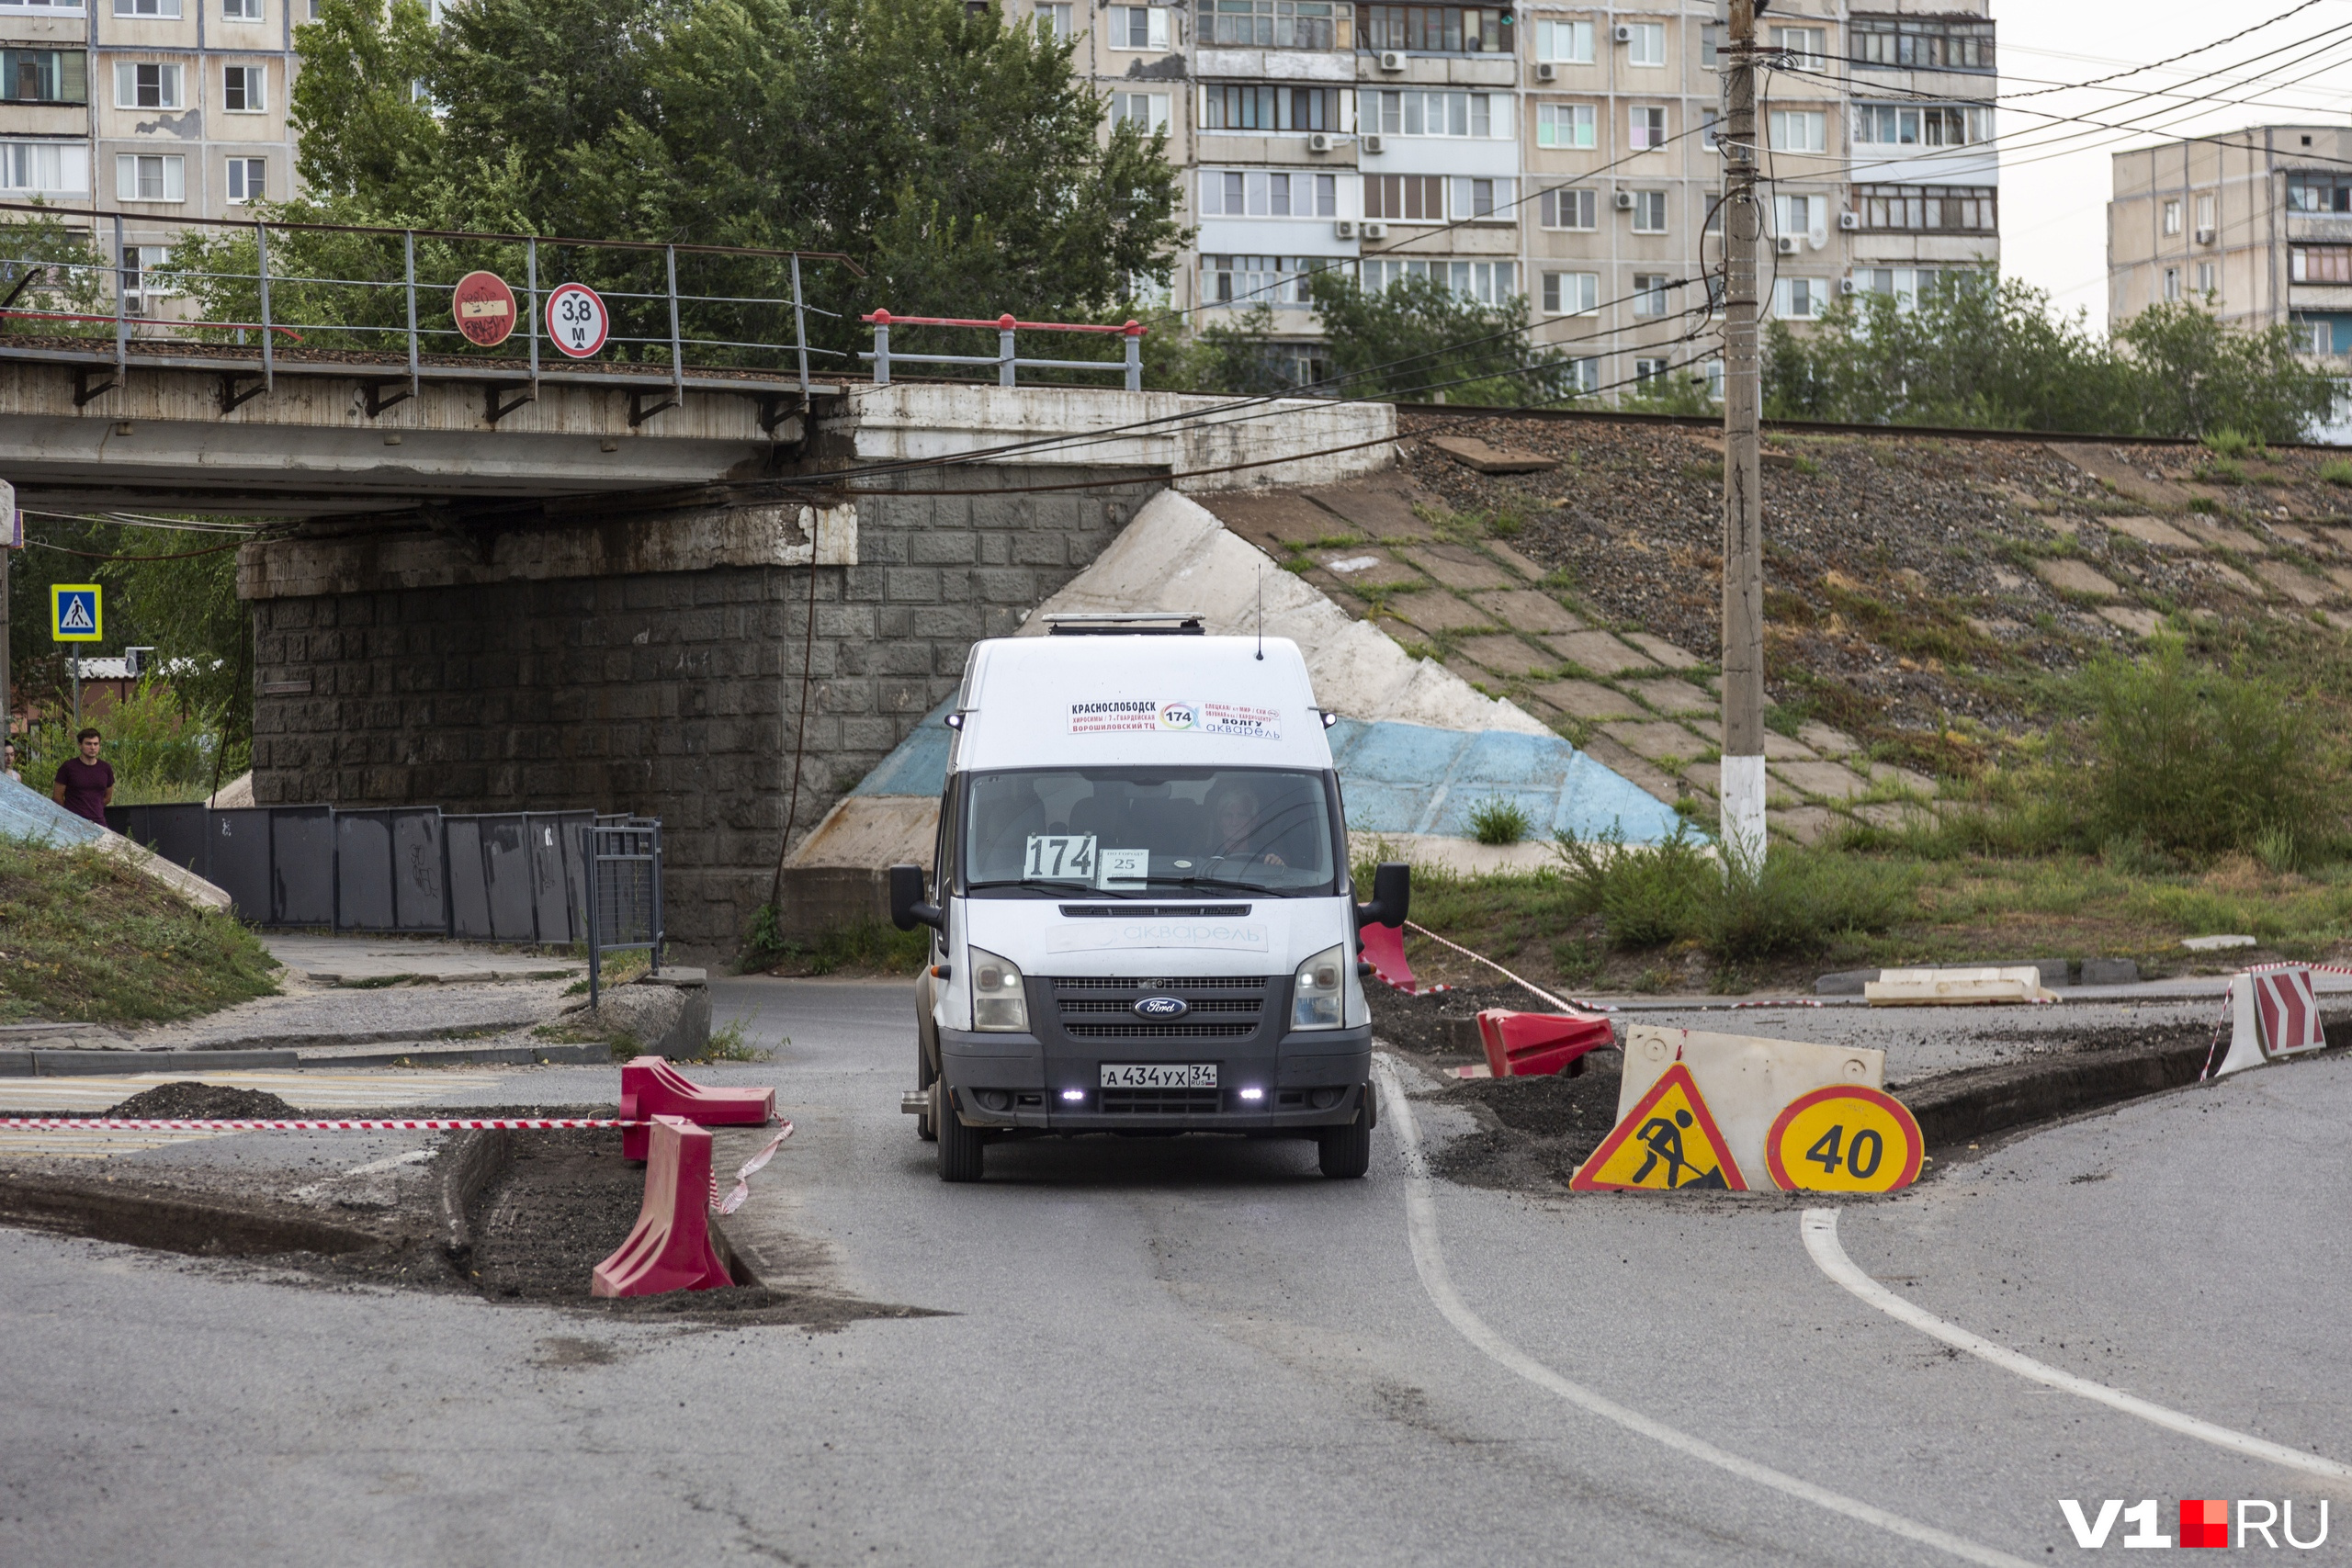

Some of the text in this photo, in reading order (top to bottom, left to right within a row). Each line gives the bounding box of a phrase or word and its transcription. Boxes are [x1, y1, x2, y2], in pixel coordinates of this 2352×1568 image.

[561, 299, 592, 324] 3,8
[571, 328, 585, 341] М
[1072, 702, 1156, 714] КРАСНОСЛОБОДСК
[1166, 711, 1192, 722] 174
[1222, 717, 1262, 727] ВОЛГУ
[1072, 722, 1156, 732] ВОРОШИЛОВСКИЙ ТЦ
[1206, 723, 1280, 739] акварель
[1030, 839, 1091, 875] 174
[1114, 858, 1136, 869] 25
[1124, 925, 1260, 942] акварель
[1147, 999, 1175, 1012] Ford
[1192, 1066, 1211, 1080] 34
[1804, 1124, 1883, 1179] 40
